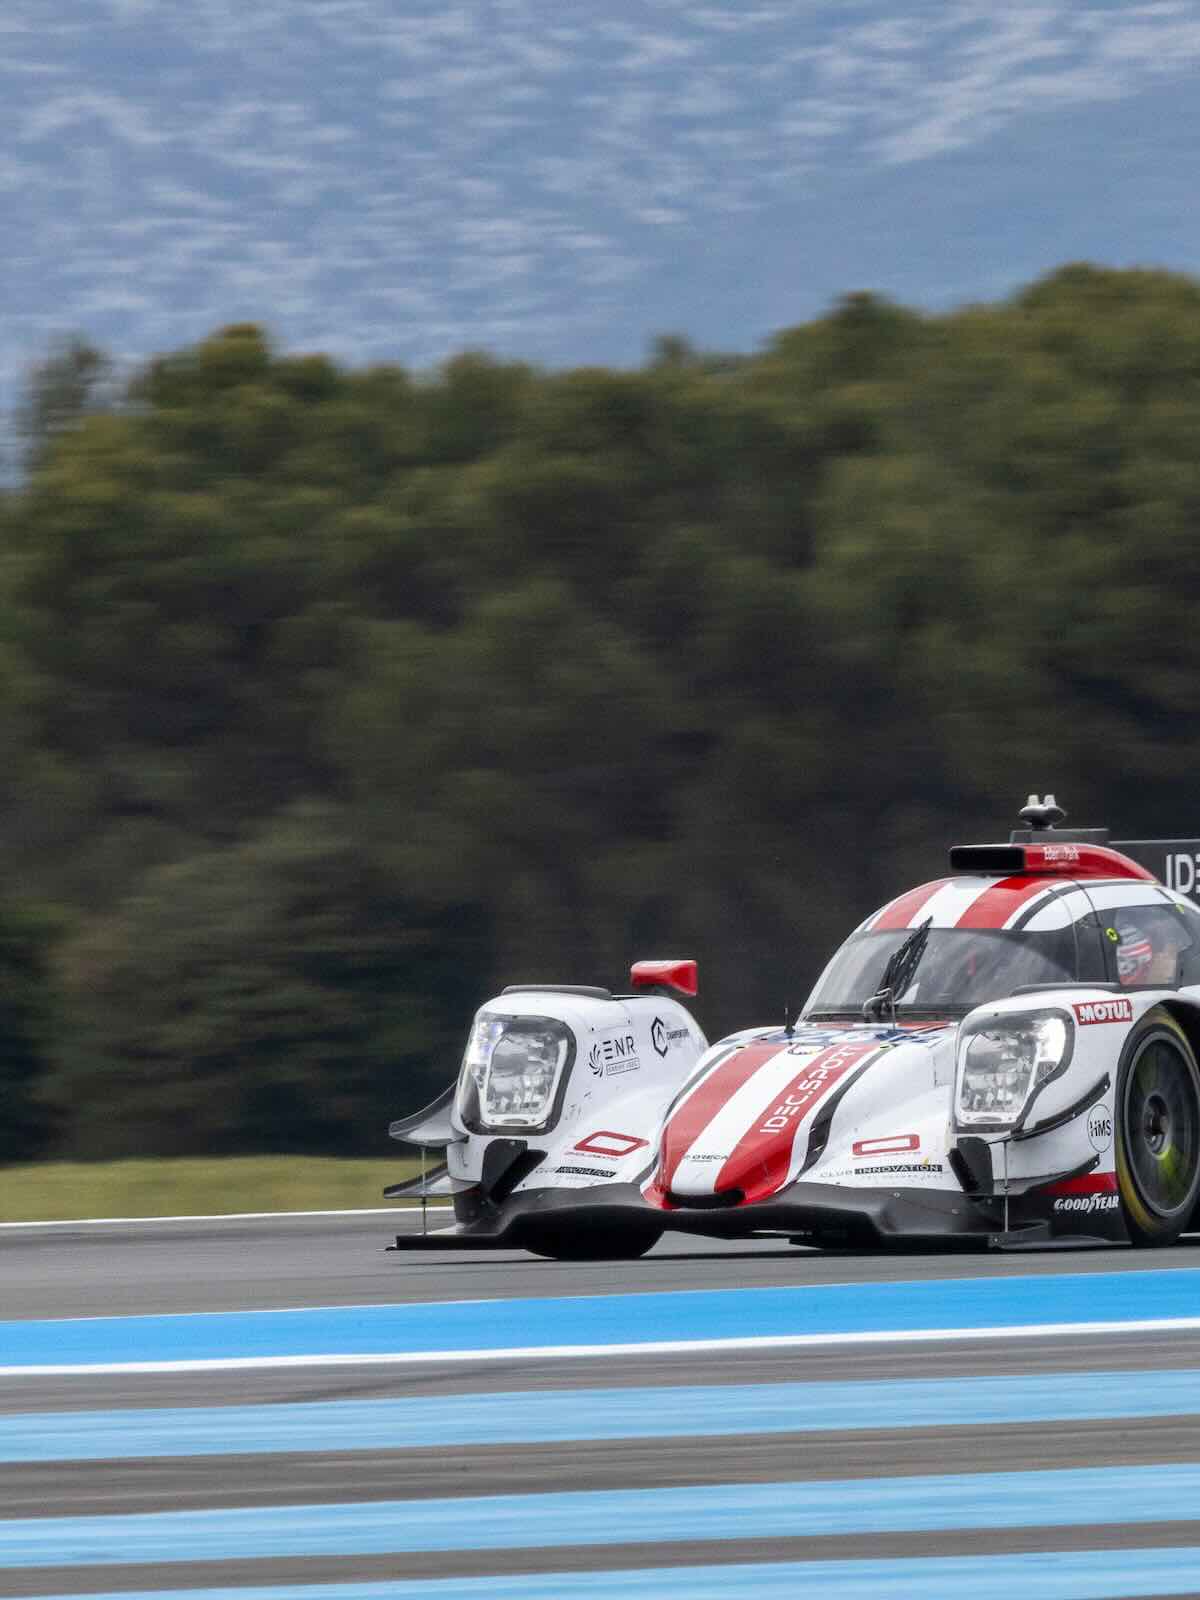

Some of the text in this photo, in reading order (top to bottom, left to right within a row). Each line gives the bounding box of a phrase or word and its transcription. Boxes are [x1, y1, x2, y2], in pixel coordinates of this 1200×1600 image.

[1079, 1002, 1131, 1021] MOTUL
[857, 1165, 941, 1174] INNOVATION
[1054, 1193, 1120, 1213] GOODYEAR
